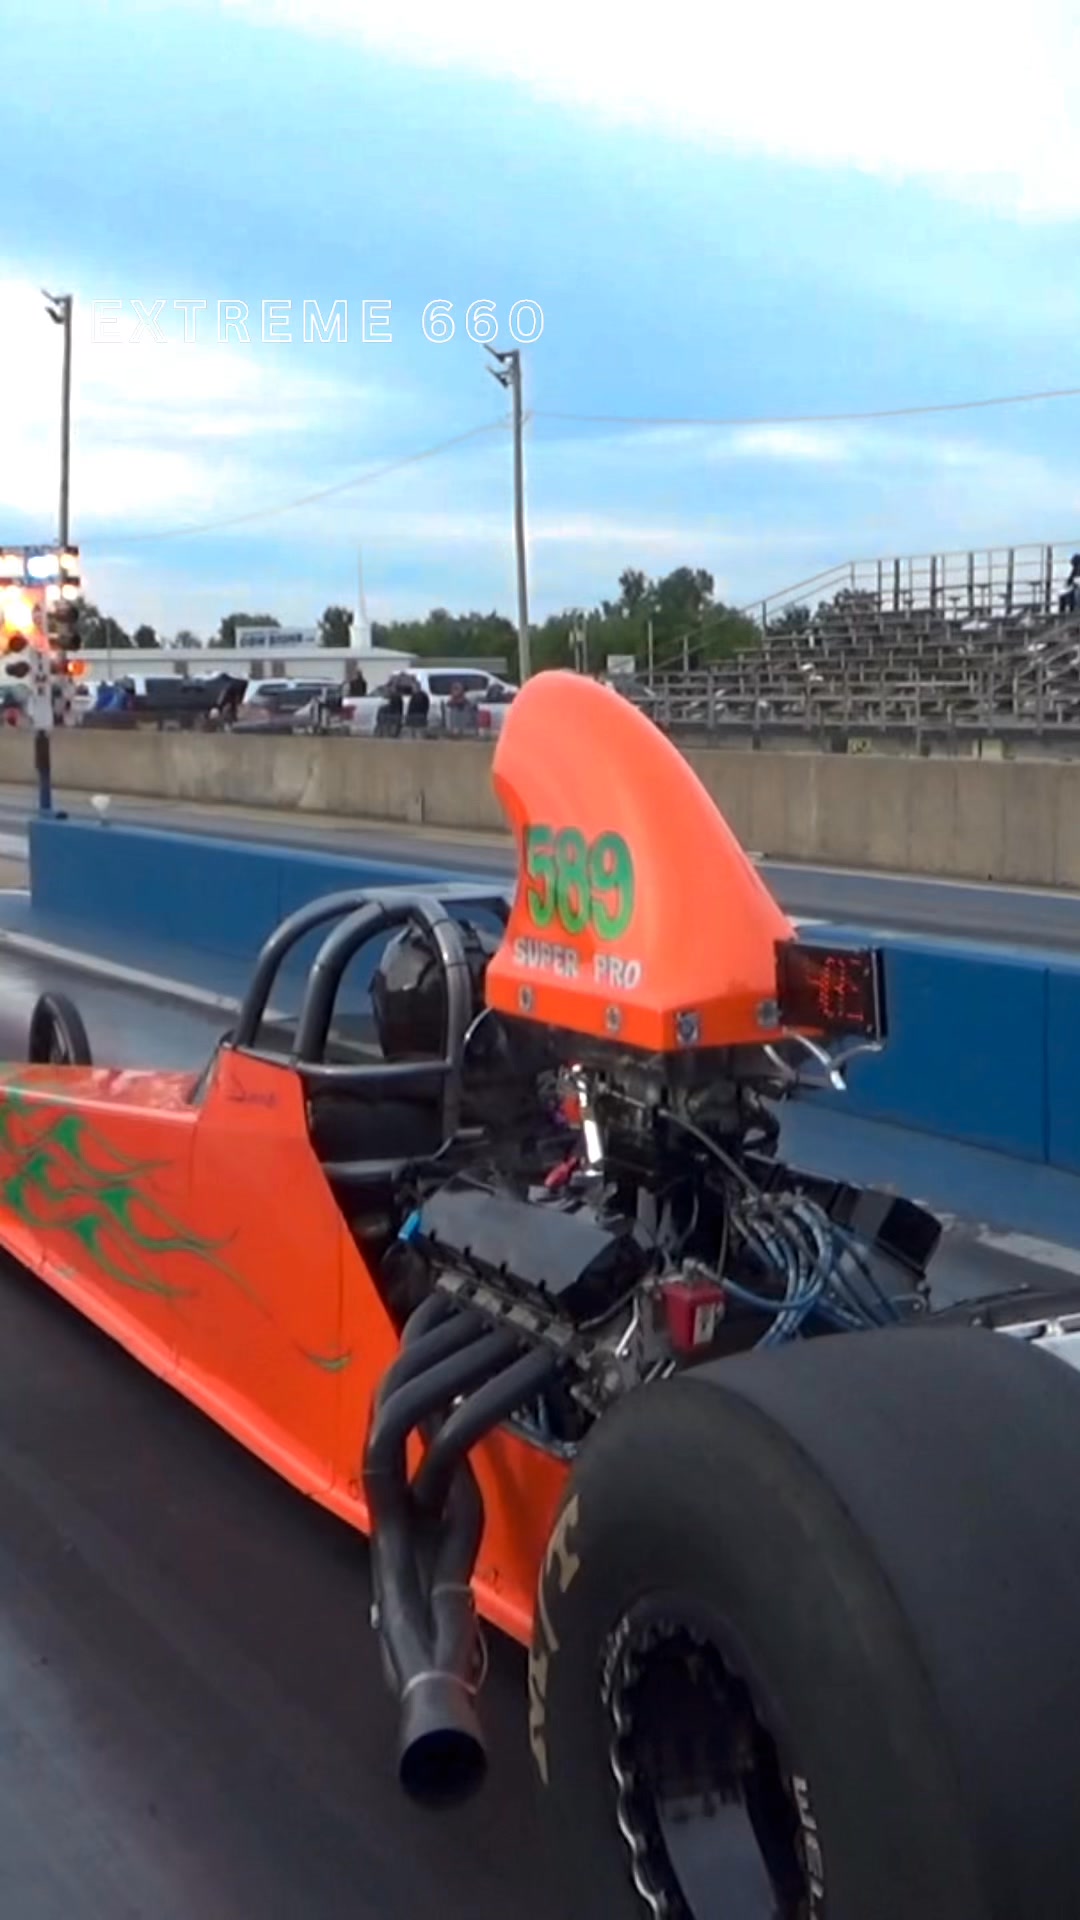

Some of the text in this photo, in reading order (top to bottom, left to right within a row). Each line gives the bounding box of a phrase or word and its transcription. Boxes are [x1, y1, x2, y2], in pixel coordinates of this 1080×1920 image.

[525, 824, 634, 942] 589
[514, 937, 642, 990] SUPER PRO
